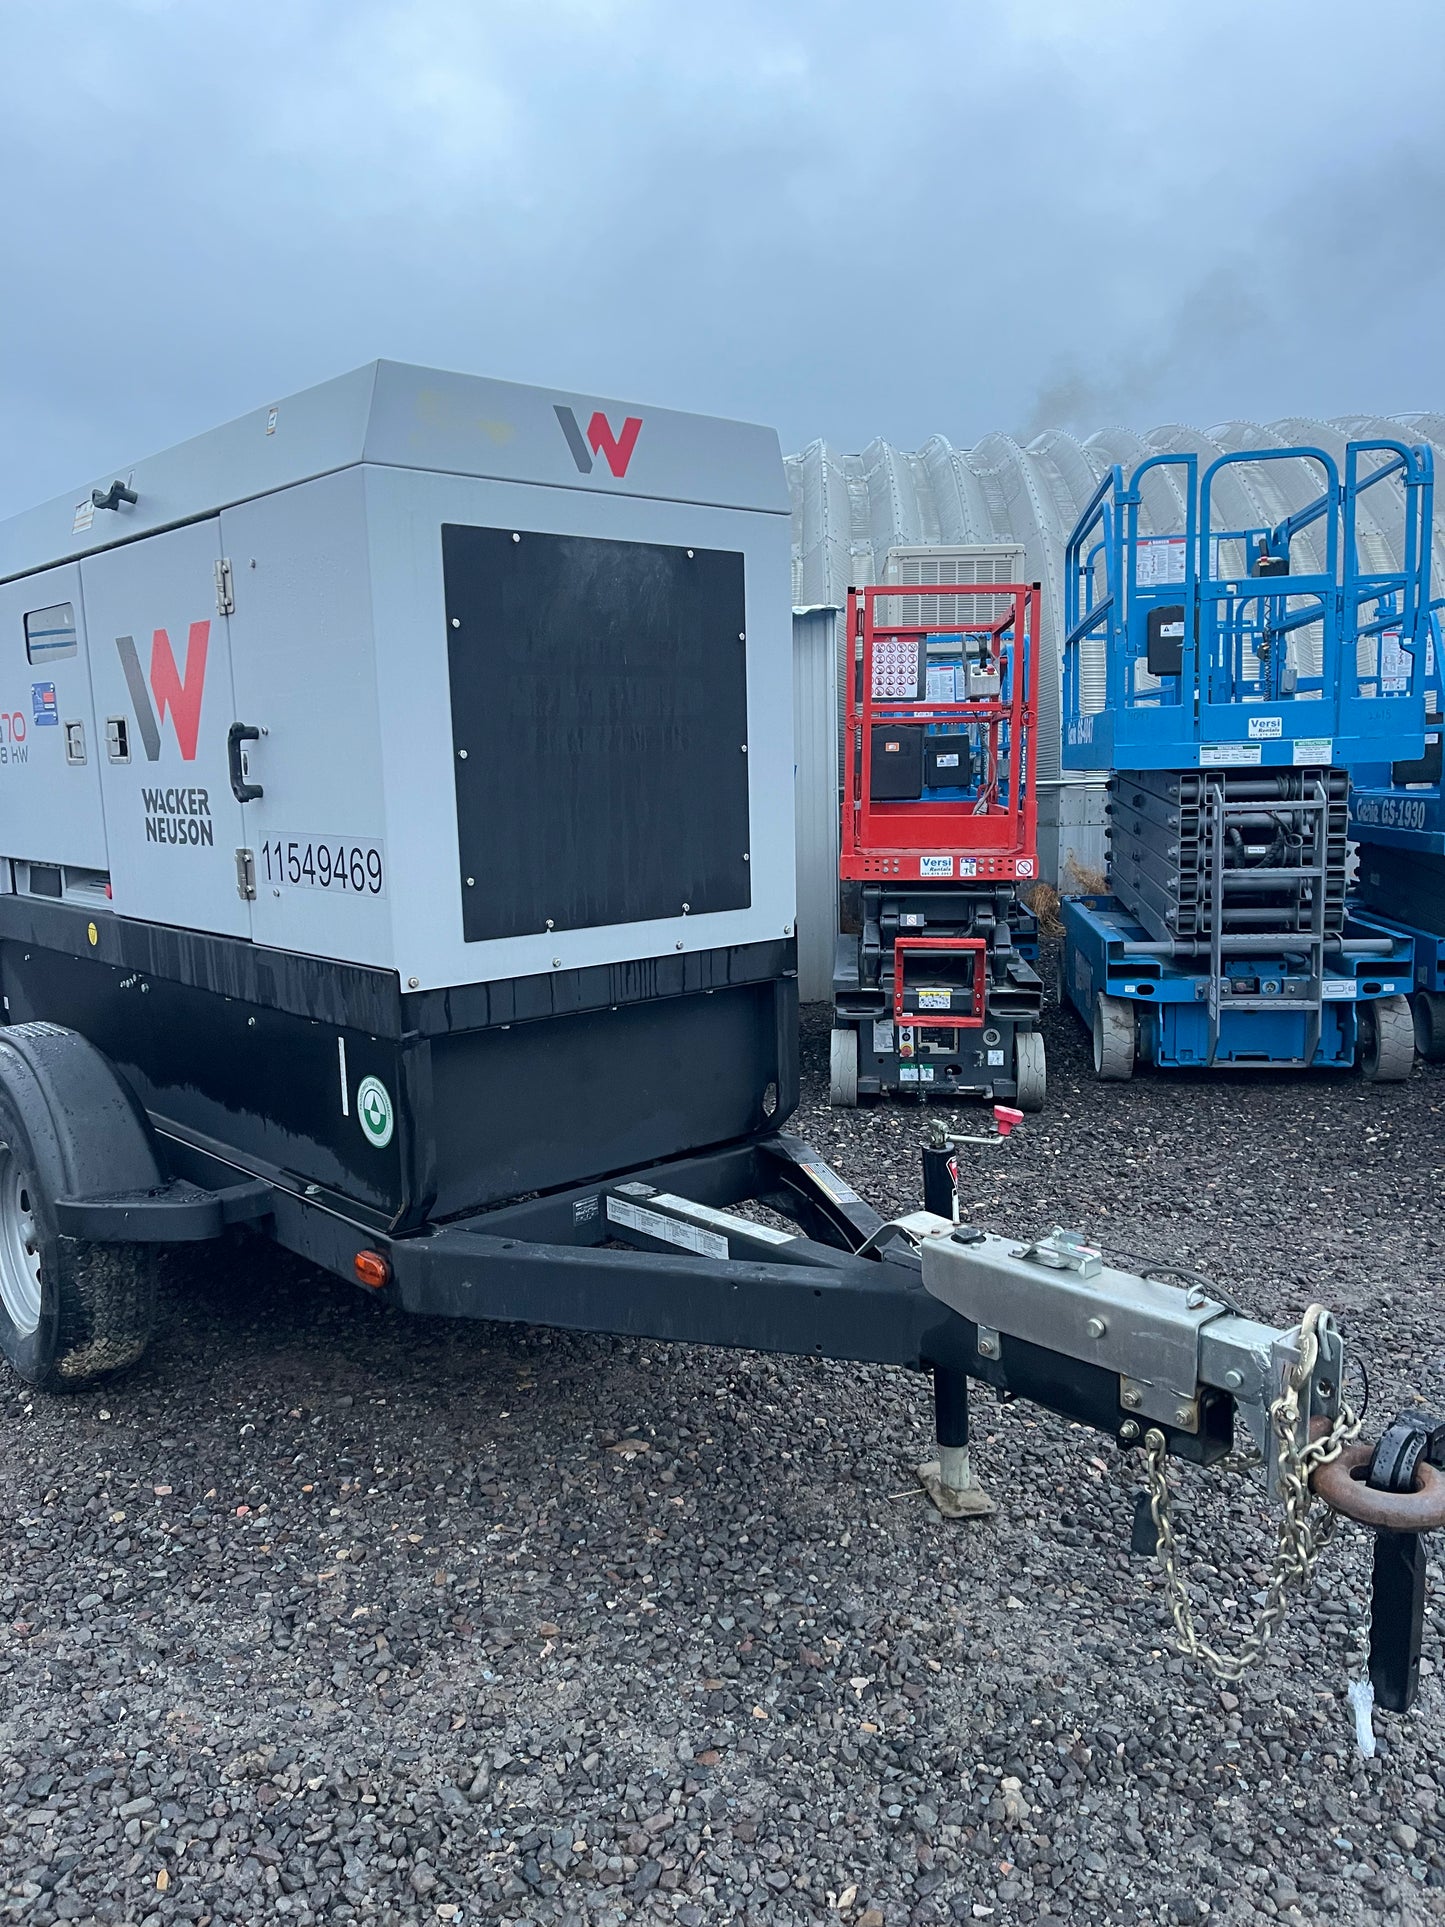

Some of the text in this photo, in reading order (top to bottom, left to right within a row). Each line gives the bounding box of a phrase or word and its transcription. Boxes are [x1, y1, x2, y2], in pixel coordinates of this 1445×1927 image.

[1251, 719, 1281, 728] Versi
[141, 787, 211, 816] WACKER
[1381, 799, 1426, 829] GS-1930
[145, 816, 214, 847] NEUSON
[261, 839, 383, 894] 11549469
[922, 857, 952, 867] Versi
